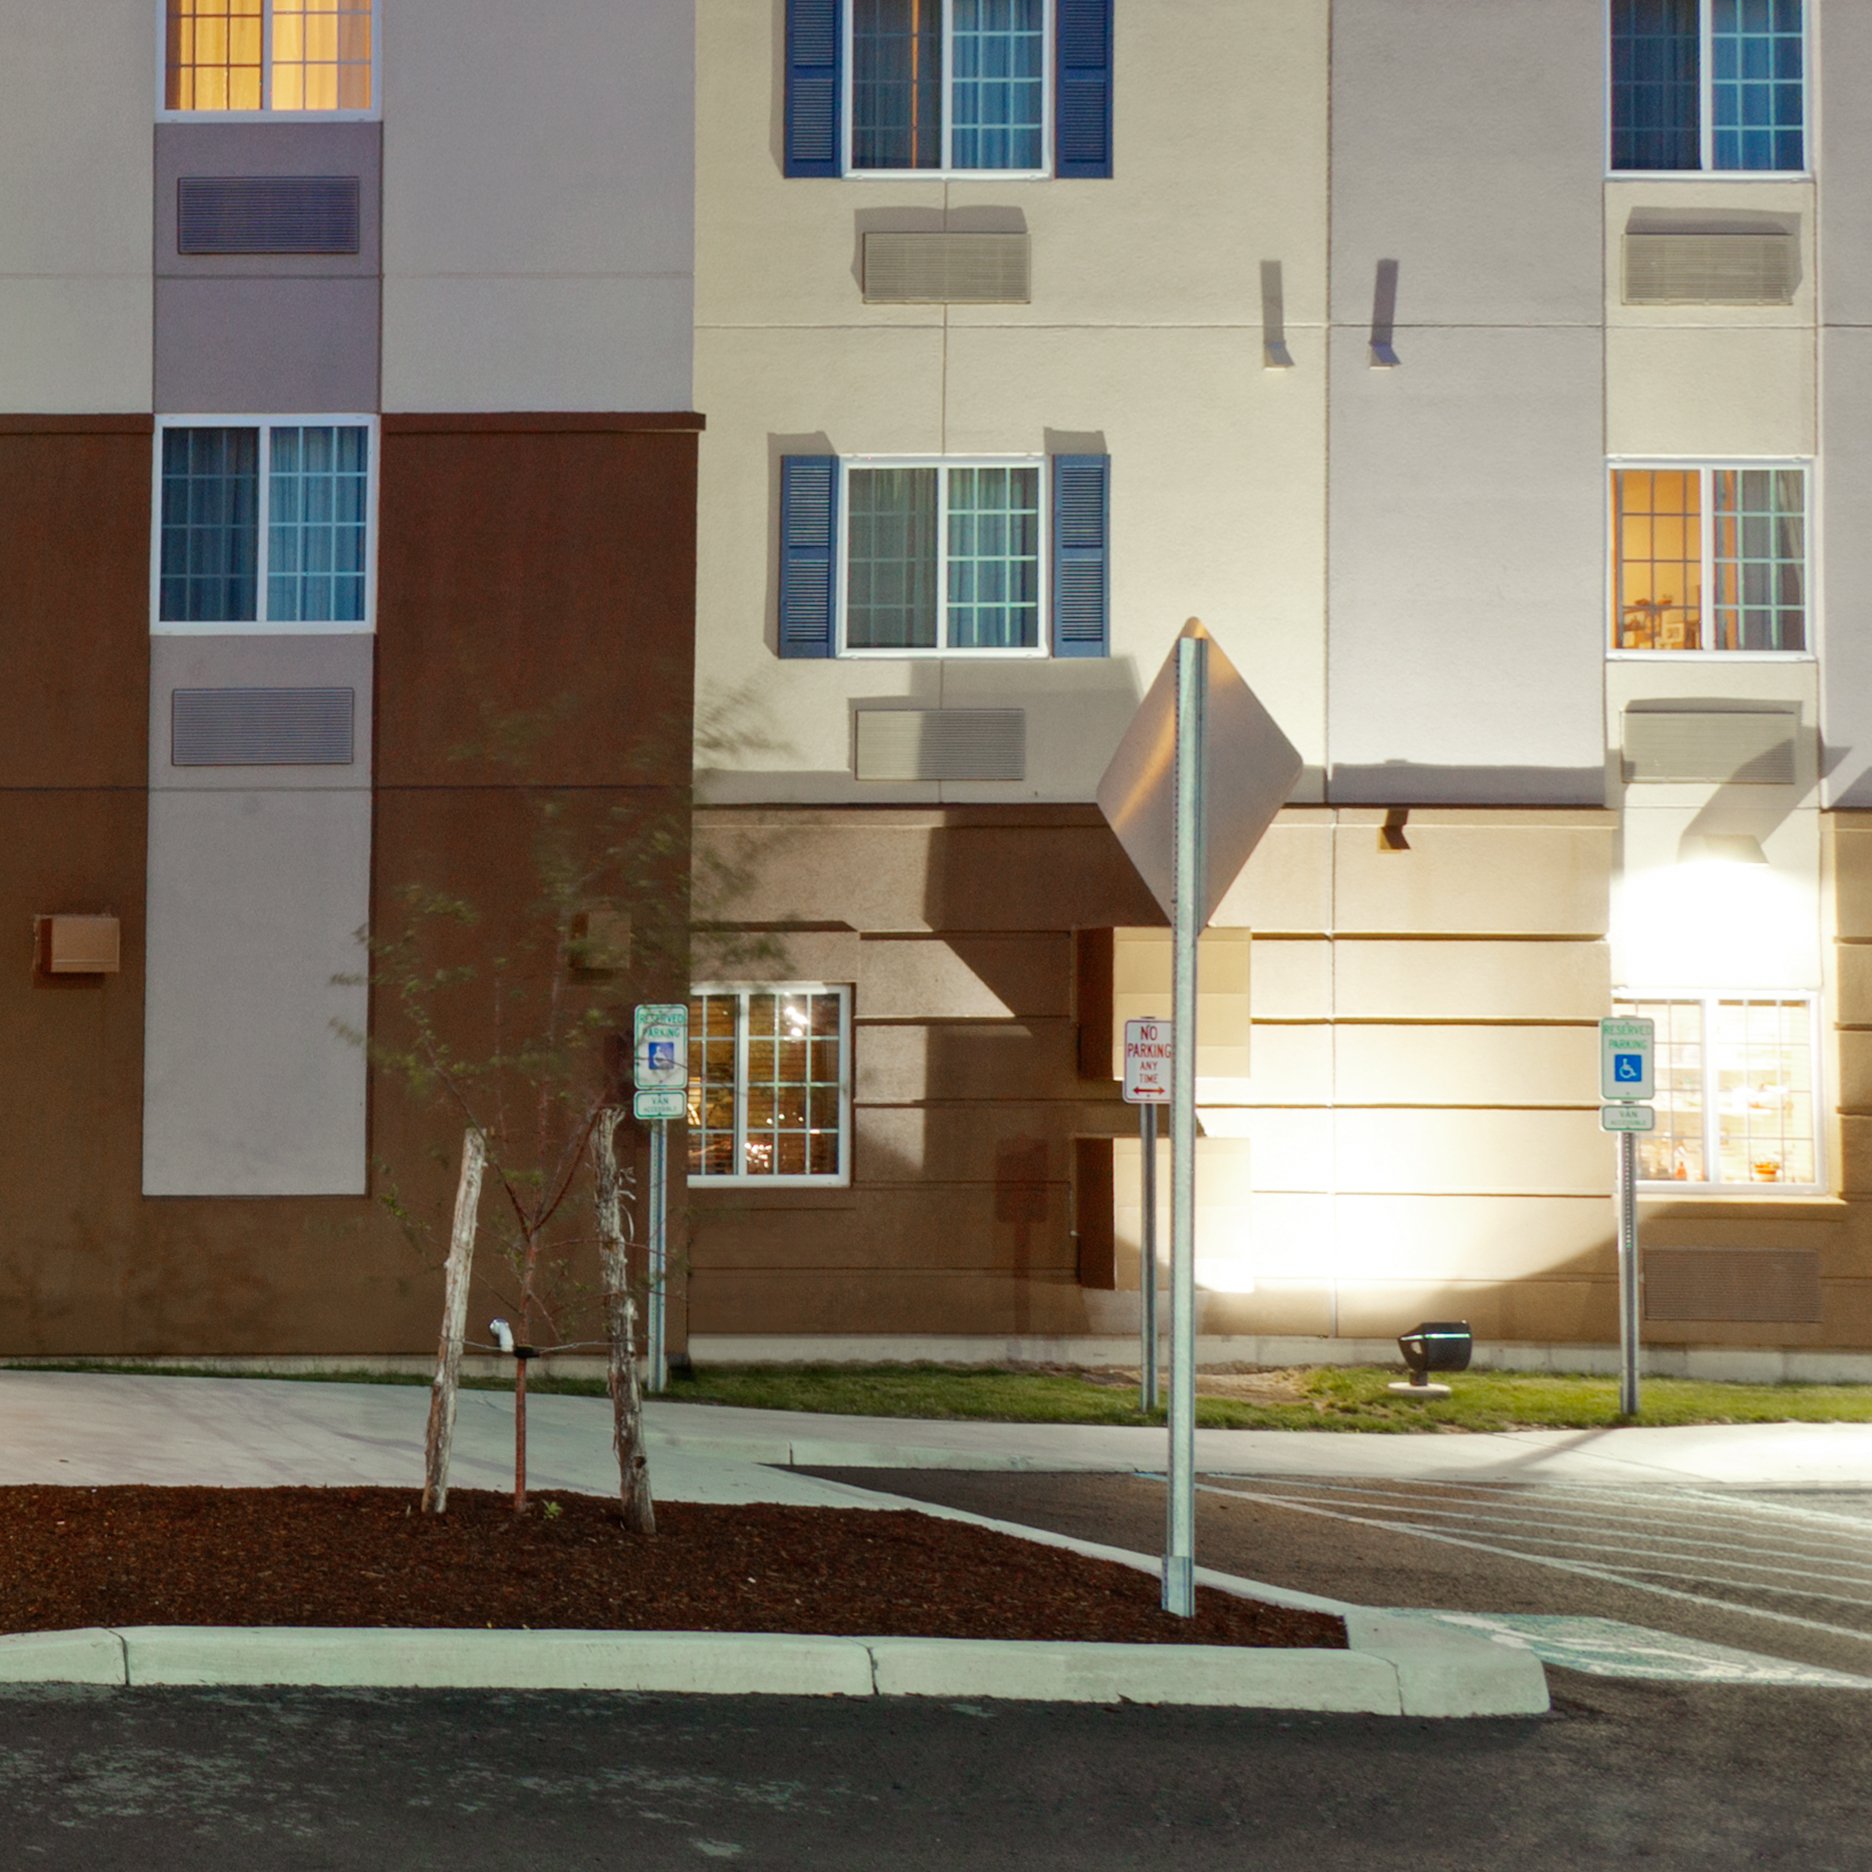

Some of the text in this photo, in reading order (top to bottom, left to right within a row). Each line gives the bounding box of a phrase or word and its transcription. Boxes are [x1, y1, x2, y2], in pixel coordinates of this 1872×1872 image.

[1140, 1024, 1158, 1041] NO
[1602, 1024, 1652, 1035] RESERVED
[1608, 1039, 1647, 1050] PARKING
[1127, 1042, 1172, 1059] PARKING
[1139, 1061, 1158, 1071] ANY
[1139, 1073, 1158, 1084] TIME
[650, 1096, 669, 1105] VAN
[1618, 1110, 1638, 1118] VAN
